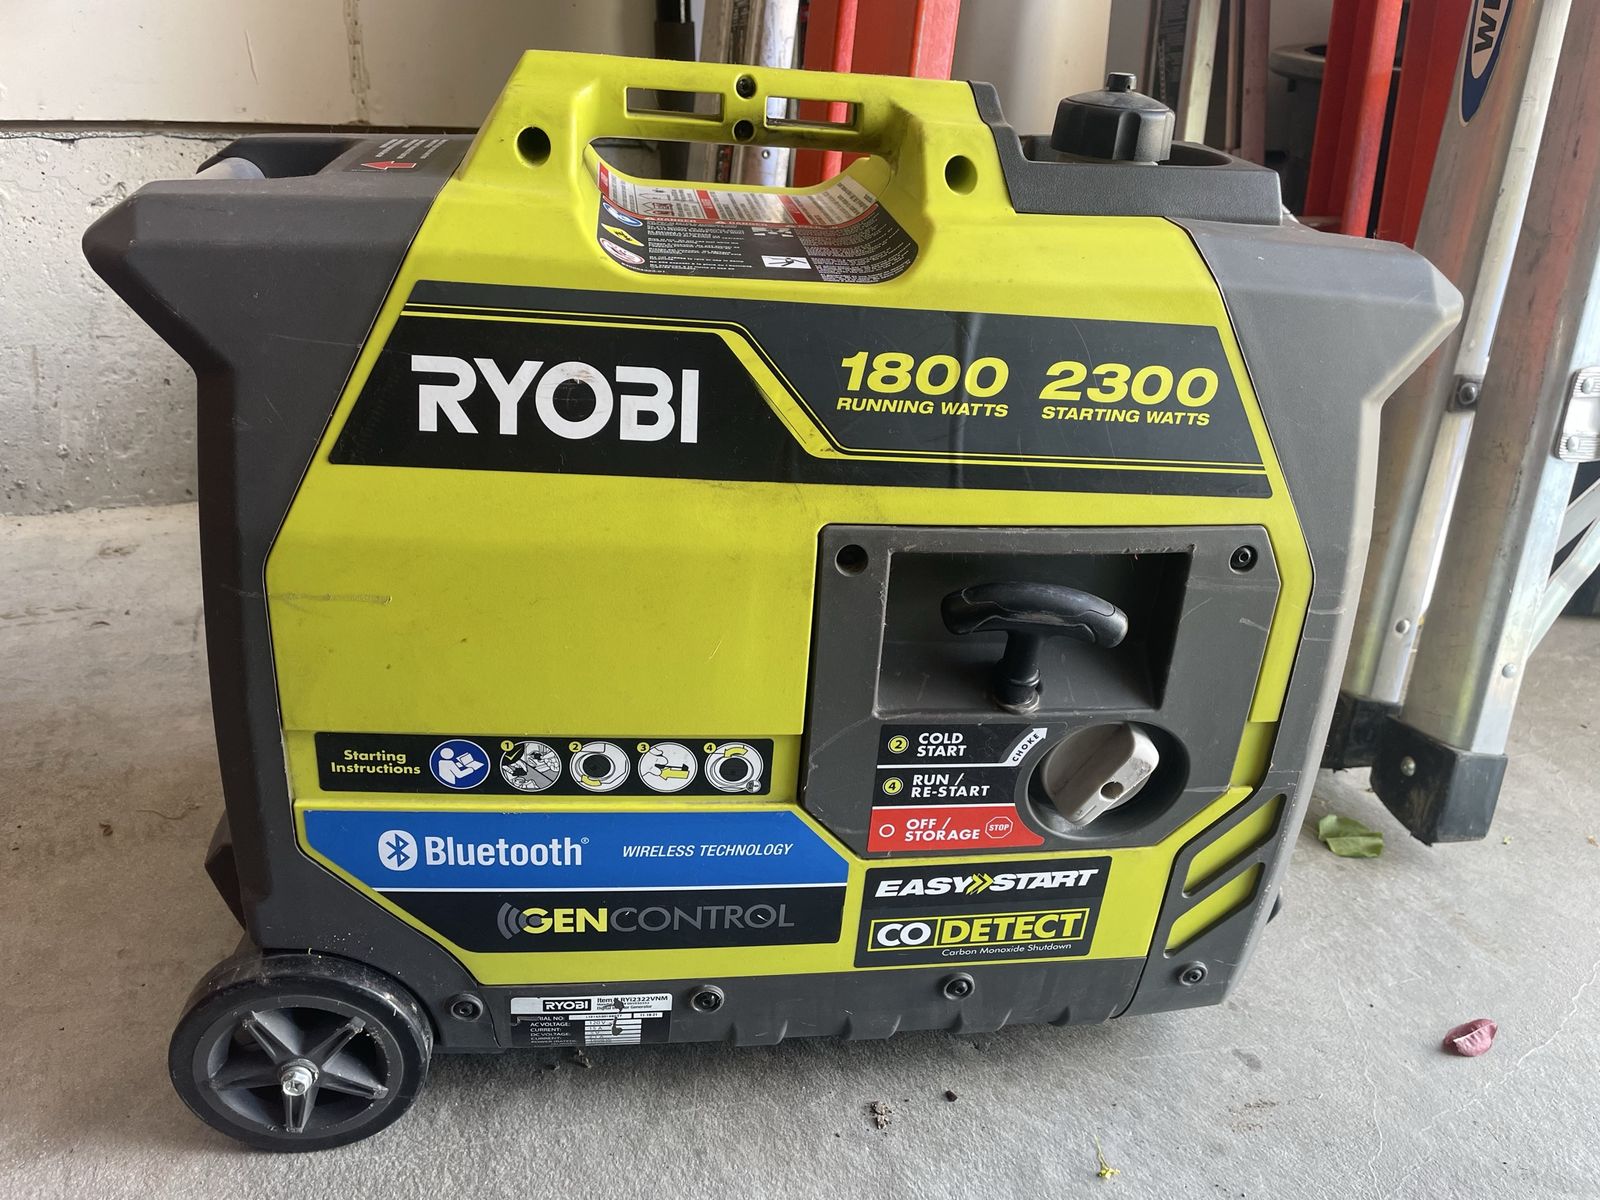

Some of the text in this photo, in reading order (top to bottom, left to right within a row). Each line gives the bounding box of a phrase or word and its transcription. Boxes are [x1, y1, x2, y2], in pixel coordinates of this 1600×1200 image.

[840, 351, 1219, 408] 1800 2300
[411, 354, 700, 444] RYOBI
[836, 397, 1009, 418] RUNNING WATTS
[1041, 406, 1211, 427] STARTING WATTS
[918, 732, 964, 745] COLD
[916, 745, 967, 757] START
[1012, 733, 1039, 762] CHOKE
[343, 749, 407, 764] Starting
[331, 761, 422, 775] Instructions
[913, 774, 950, 786] RUN
[911, 785, 990, 798] RE-START
[906, 818, 937, 830] OFF
[988, 823, 1010, 832] STOP
[904, 829, 980, 842] STORAGE
[623, 845, 695, 857] WIRELESS
[700, 843, 794, 857] TECHNOLOGY
[875, 868, 1099, 898] EASY START
[876, 912, 1083, 947] CO DETECT
[941, 943, 1072, 957] Carbon Monoxide Shutdown
[545, 1000, 589, 1010] RYOBI
